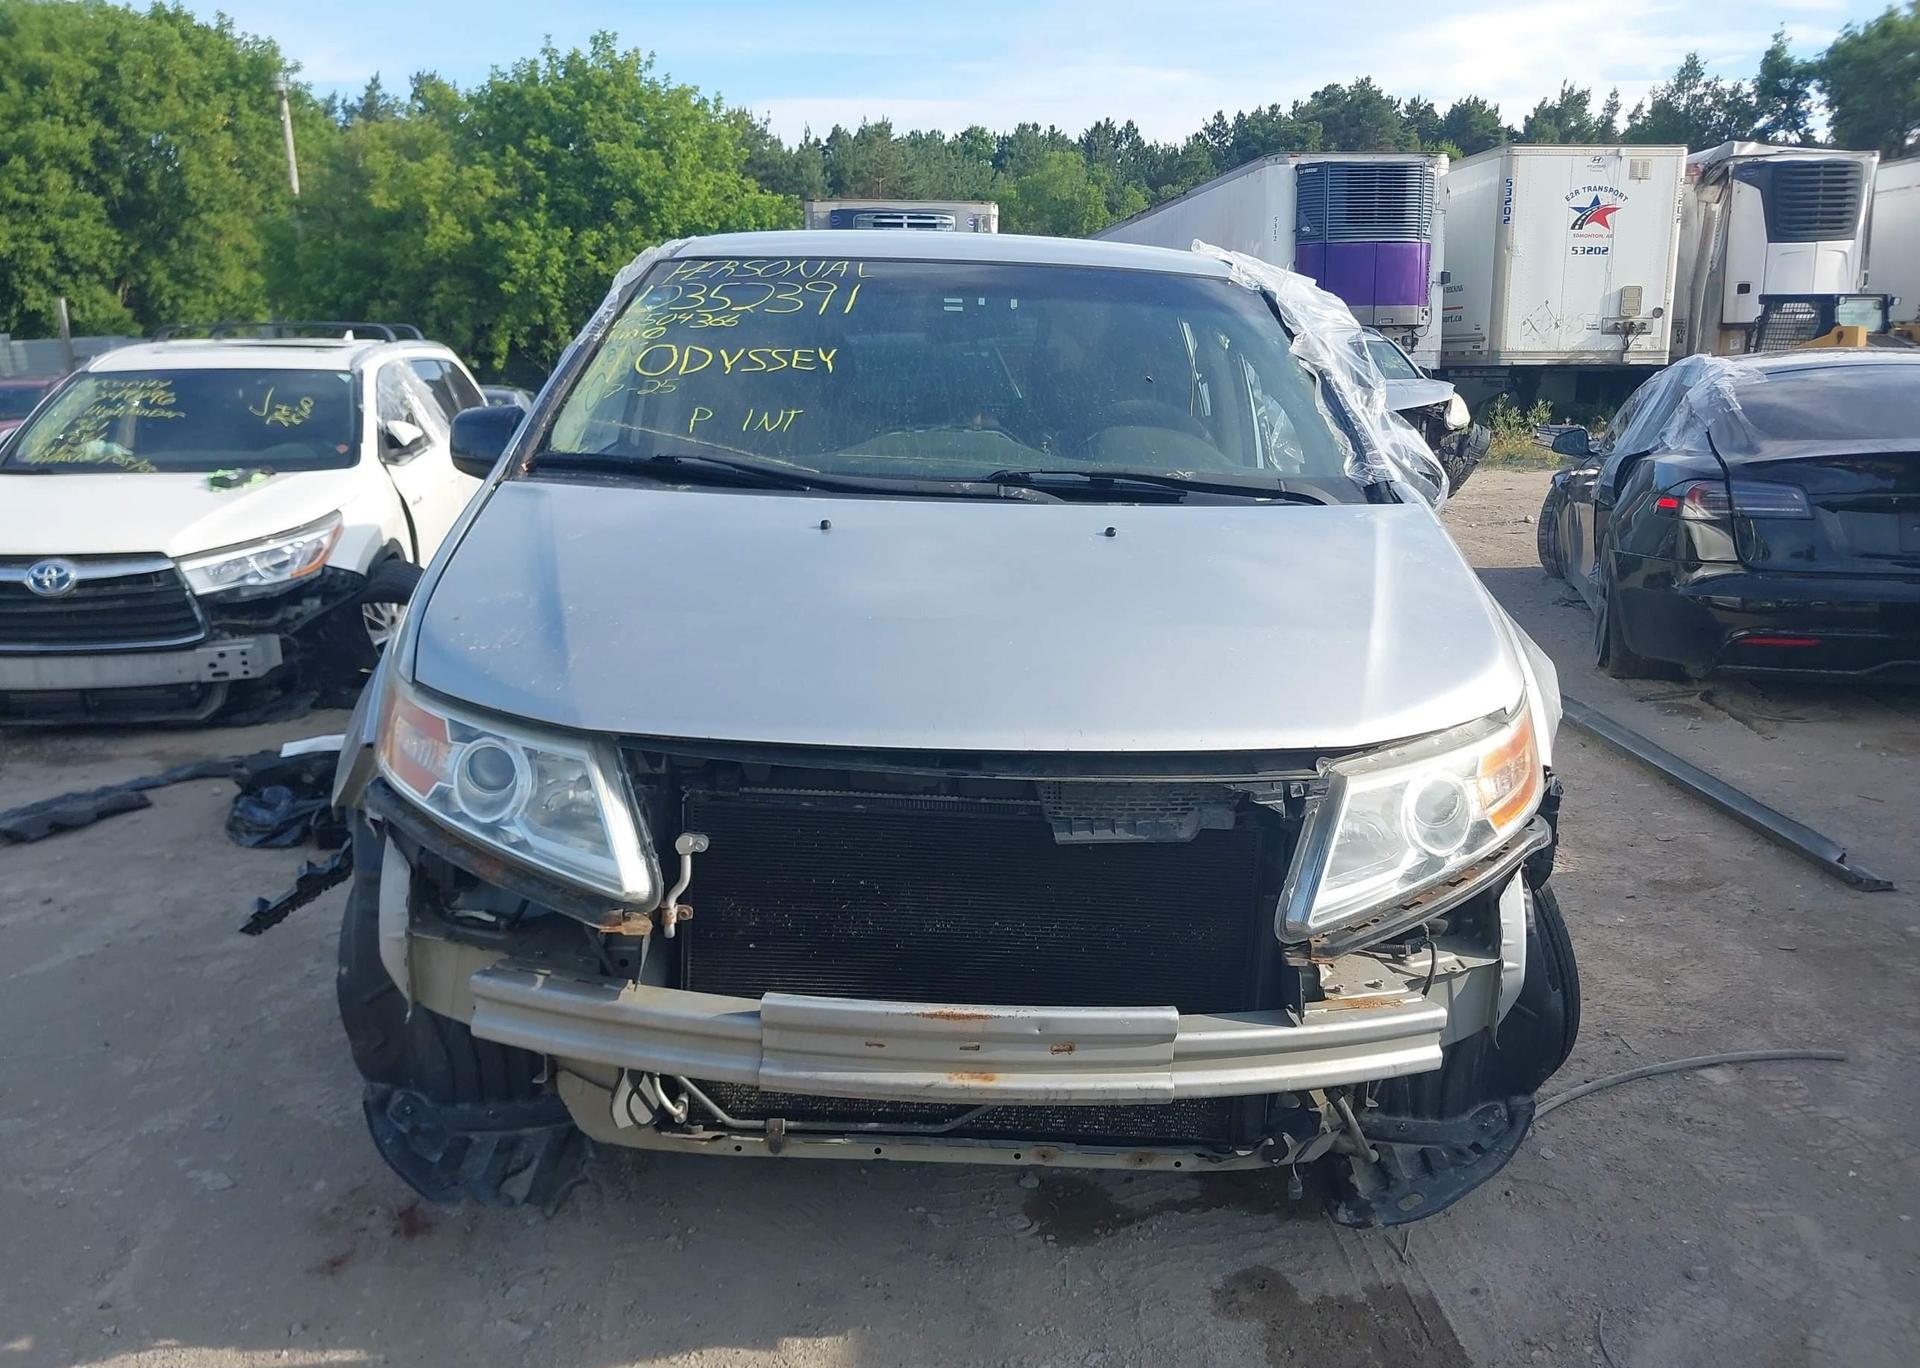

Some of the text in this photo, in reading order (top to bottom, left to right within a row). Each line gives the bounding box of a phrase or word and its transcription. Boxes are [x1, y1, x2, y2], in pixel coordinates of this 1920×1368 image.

[1503, 178, 1513, 225] 53202
[1564, 185, 1629, 202] E2R TRANSPORT
[1571, 246, 1609, 255] 53202
[663, 259, 875, 284] PERSONAL
[634, 344, 838, 376] ODYSSEY
[689, 407, 804, 434] P INT
